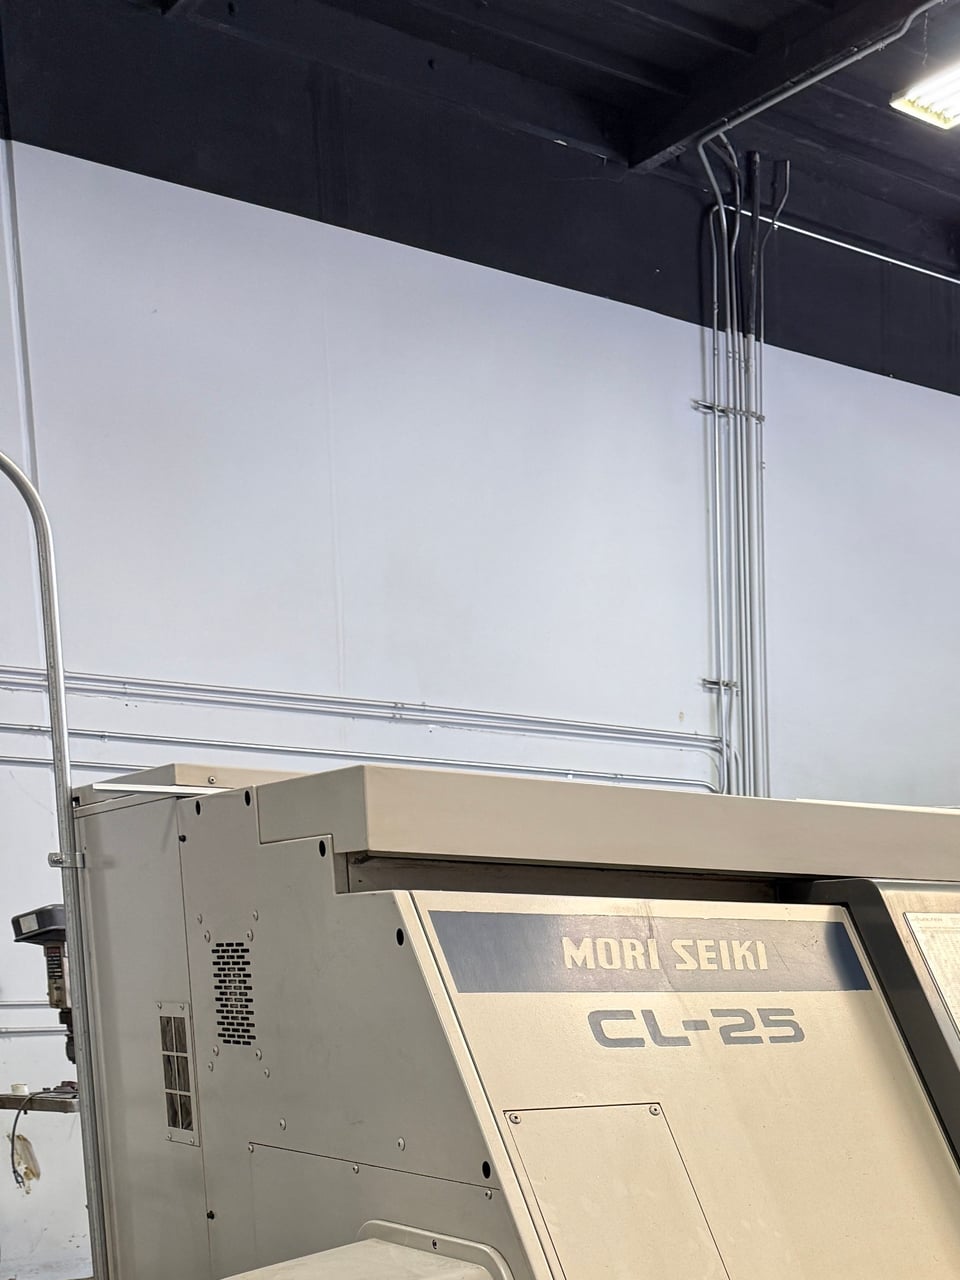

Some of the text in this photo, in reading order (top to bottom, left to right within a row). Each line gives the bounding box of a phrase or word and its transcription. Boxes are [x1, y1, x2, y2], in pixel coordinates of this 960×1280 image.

[562, 936, 768, 971] MORI SEIKI
[587, 1008, 805, 1049] CL-25
